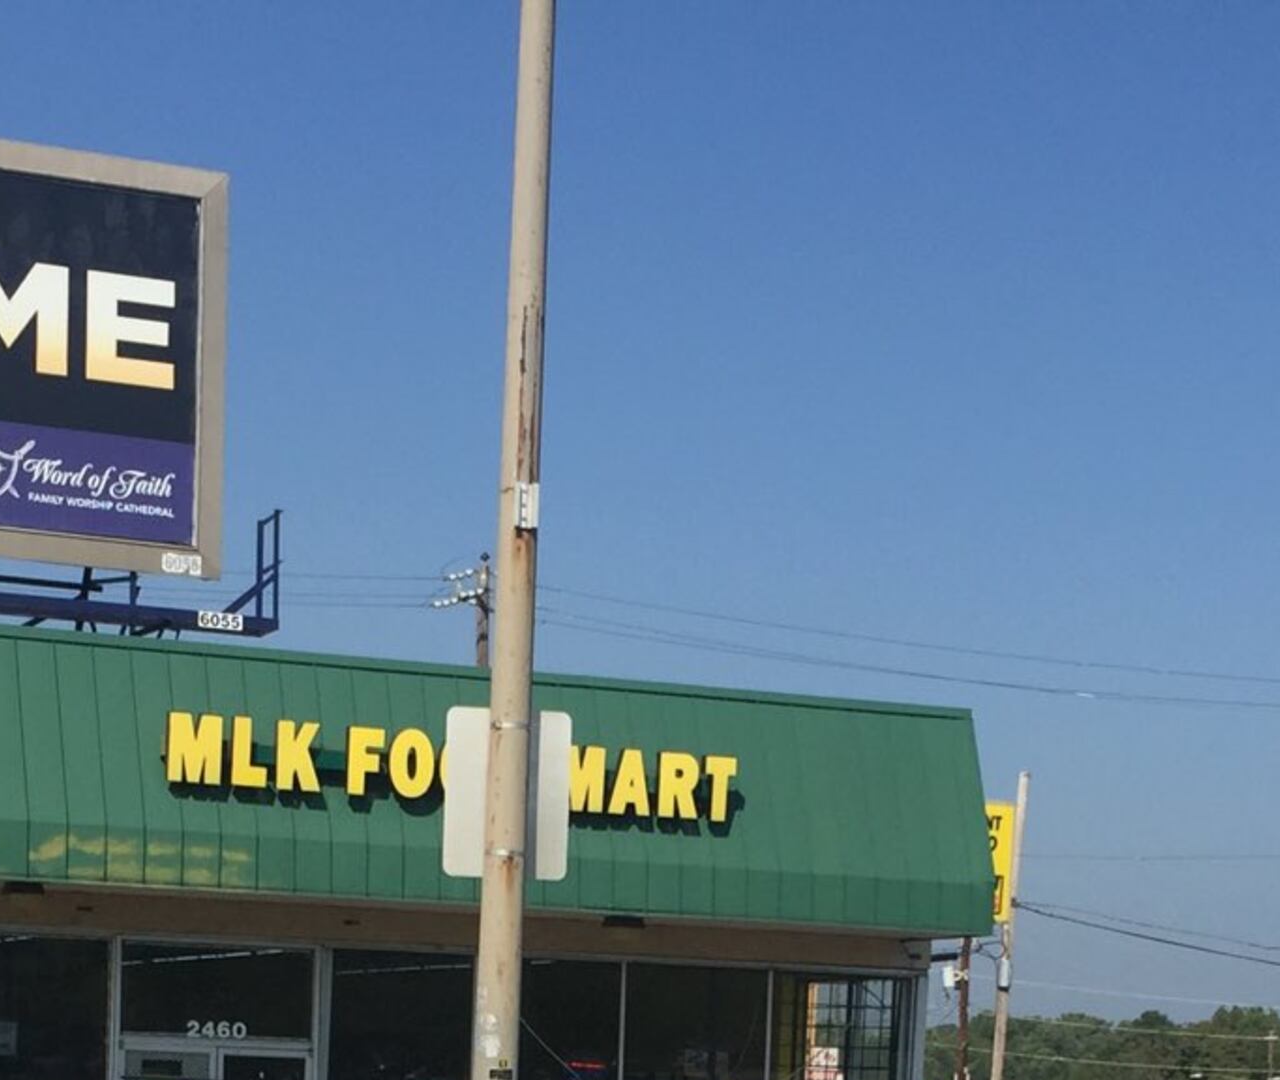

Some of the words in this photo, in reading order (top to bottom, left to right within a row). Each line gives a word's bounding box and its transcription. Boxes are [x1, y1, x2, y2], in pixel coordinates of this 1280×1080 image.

[23, 458, 94, 488] Word
[88, 464, 117, 497] of
[109, 469, 176, 499] Faith
[28, 492, 65, 506] FAMILY
[66, 497, 114, 511] WORSHIP
[115, 502, 175, 518] CATHEDRAL
[200, 612, 241, 630] 6055
[167, 710, 321, 794] MLK
[346, 725, 448, 799] FO
[570, 743, 738, 823] MART
[186, 1020, 248, 1040] 2460
